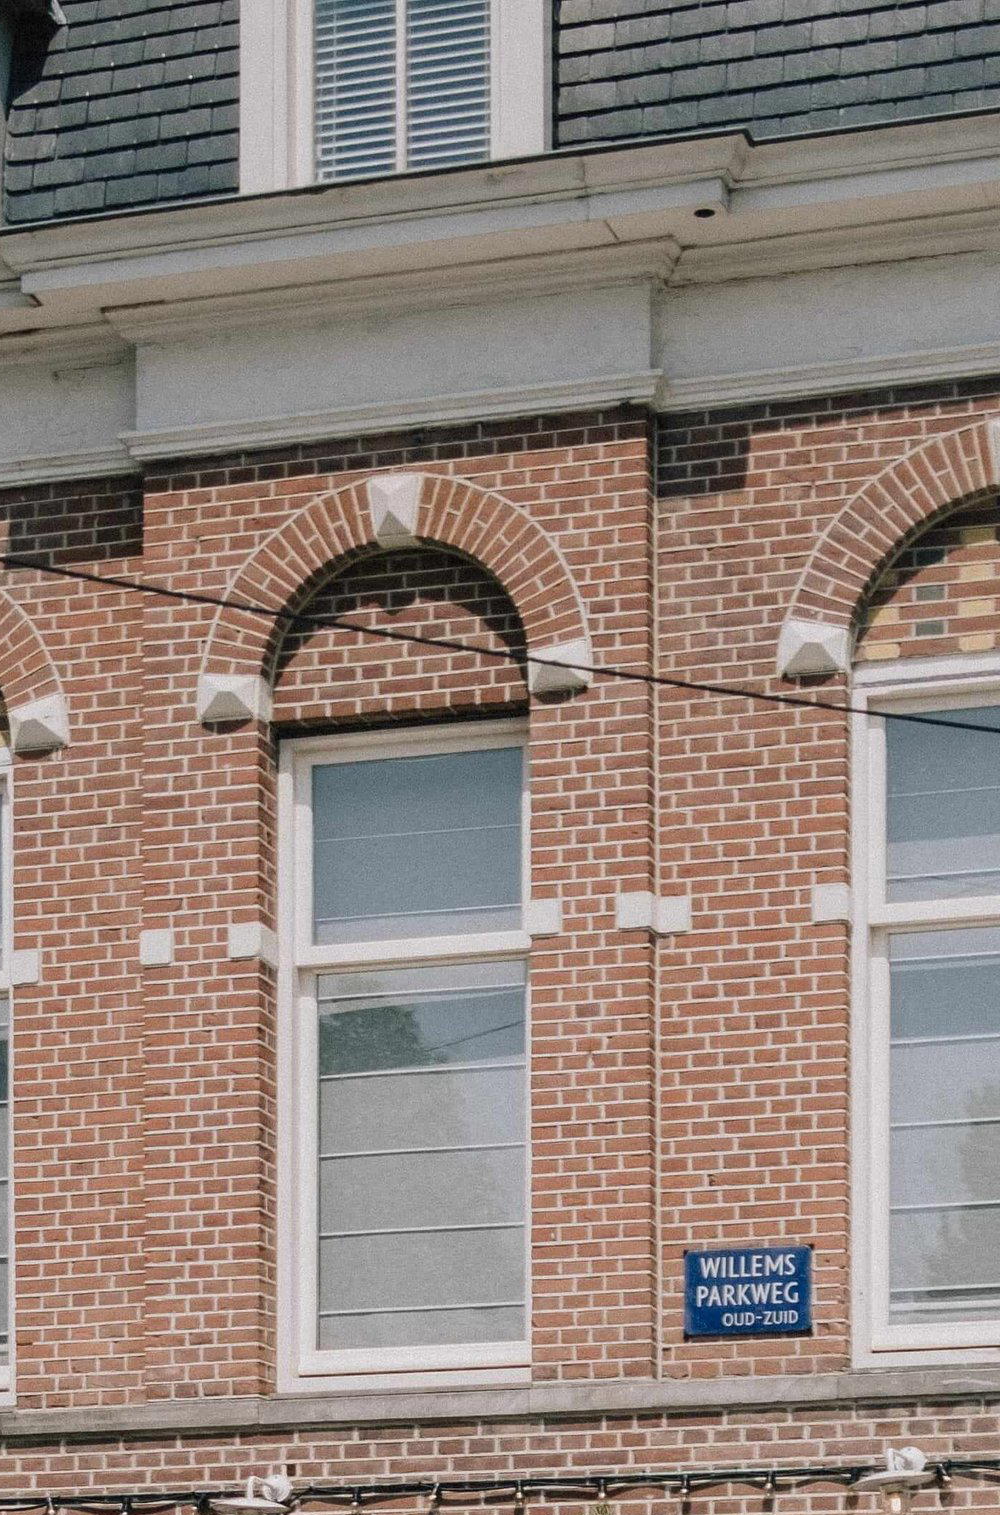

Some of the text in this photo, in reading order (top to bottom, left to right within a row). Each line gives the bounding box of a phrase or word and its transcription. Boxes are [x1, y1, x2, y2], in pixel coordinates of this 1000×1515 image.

[700, 1254, 796, 1279] WILLEMS
[696, 1281, 799, 1307] PARKWEG
[722, 1309, 799, 1327] OUD-ZUID
